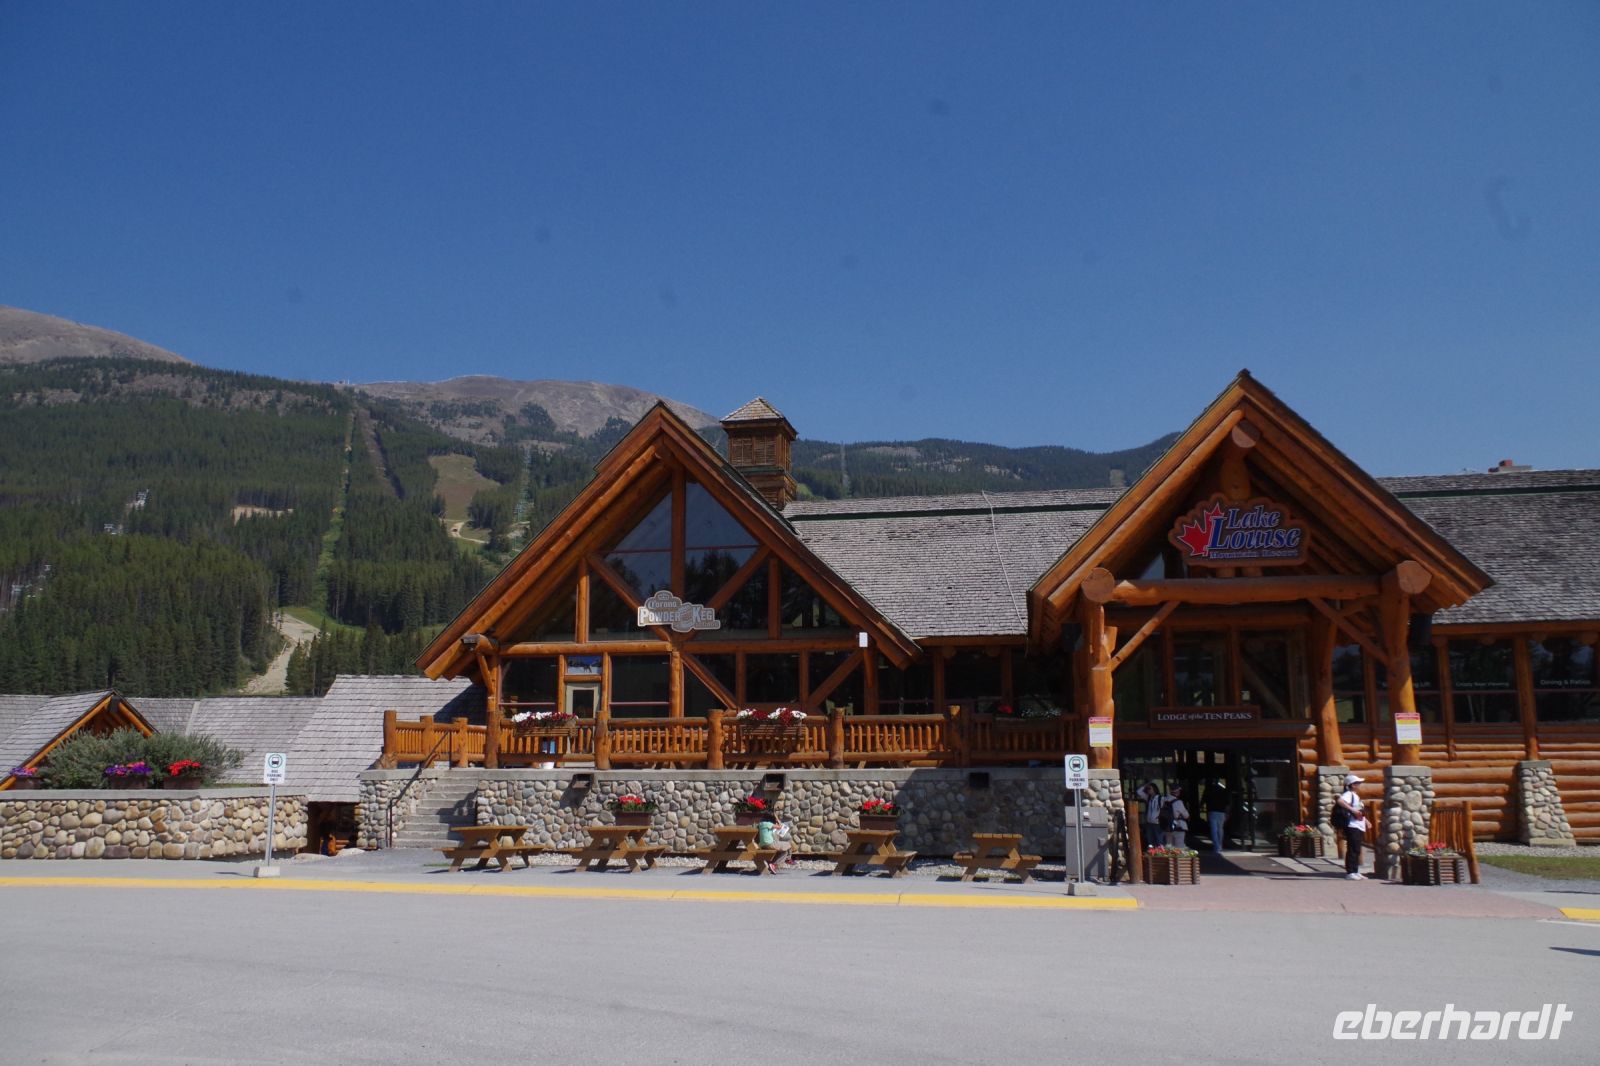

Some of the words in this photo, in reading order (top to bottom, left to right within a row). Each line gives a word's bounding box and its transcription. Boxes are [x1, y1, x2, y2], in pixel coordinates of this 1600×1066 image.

[1226, 505, 1281, 529] Lake
[1207, 515, 1301, 550] Louise
[640, 608, 681, 624] POWDER
[692, 606, 712, 622] KEG
[1157, 713, 1187, 721] LODGE
[1204, 712, 1222, 720] TEN
[1223, 712, 1252, 720] PEAKS
